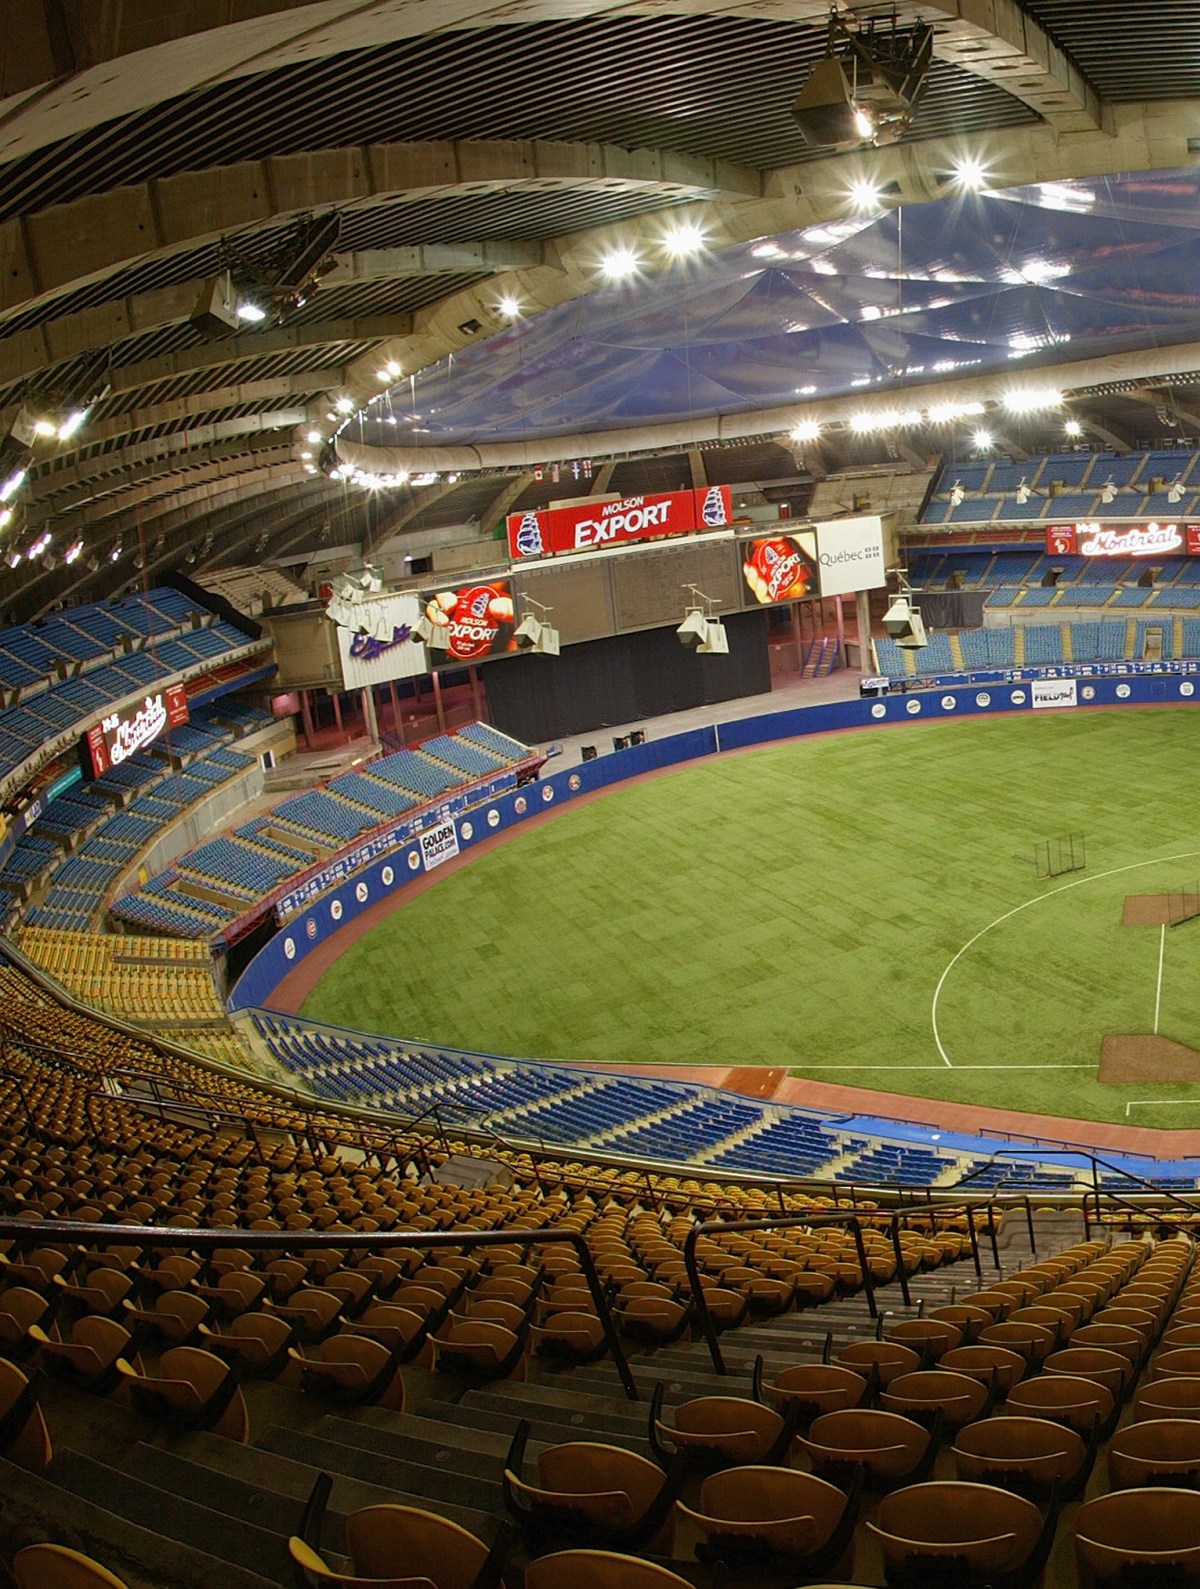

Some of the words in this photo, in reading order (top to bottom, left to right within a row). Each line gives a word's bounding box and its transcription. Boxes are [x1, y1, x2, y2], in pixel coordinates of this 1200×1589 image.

[602, 496, 645, 517] MOLSON
[575, 500, 672, 549] EXPORT
[820, 549, 863, 567] Québec
[768, 553, 801, 598] EXPORT
[422, 825, 454, 850] GOLDEN
